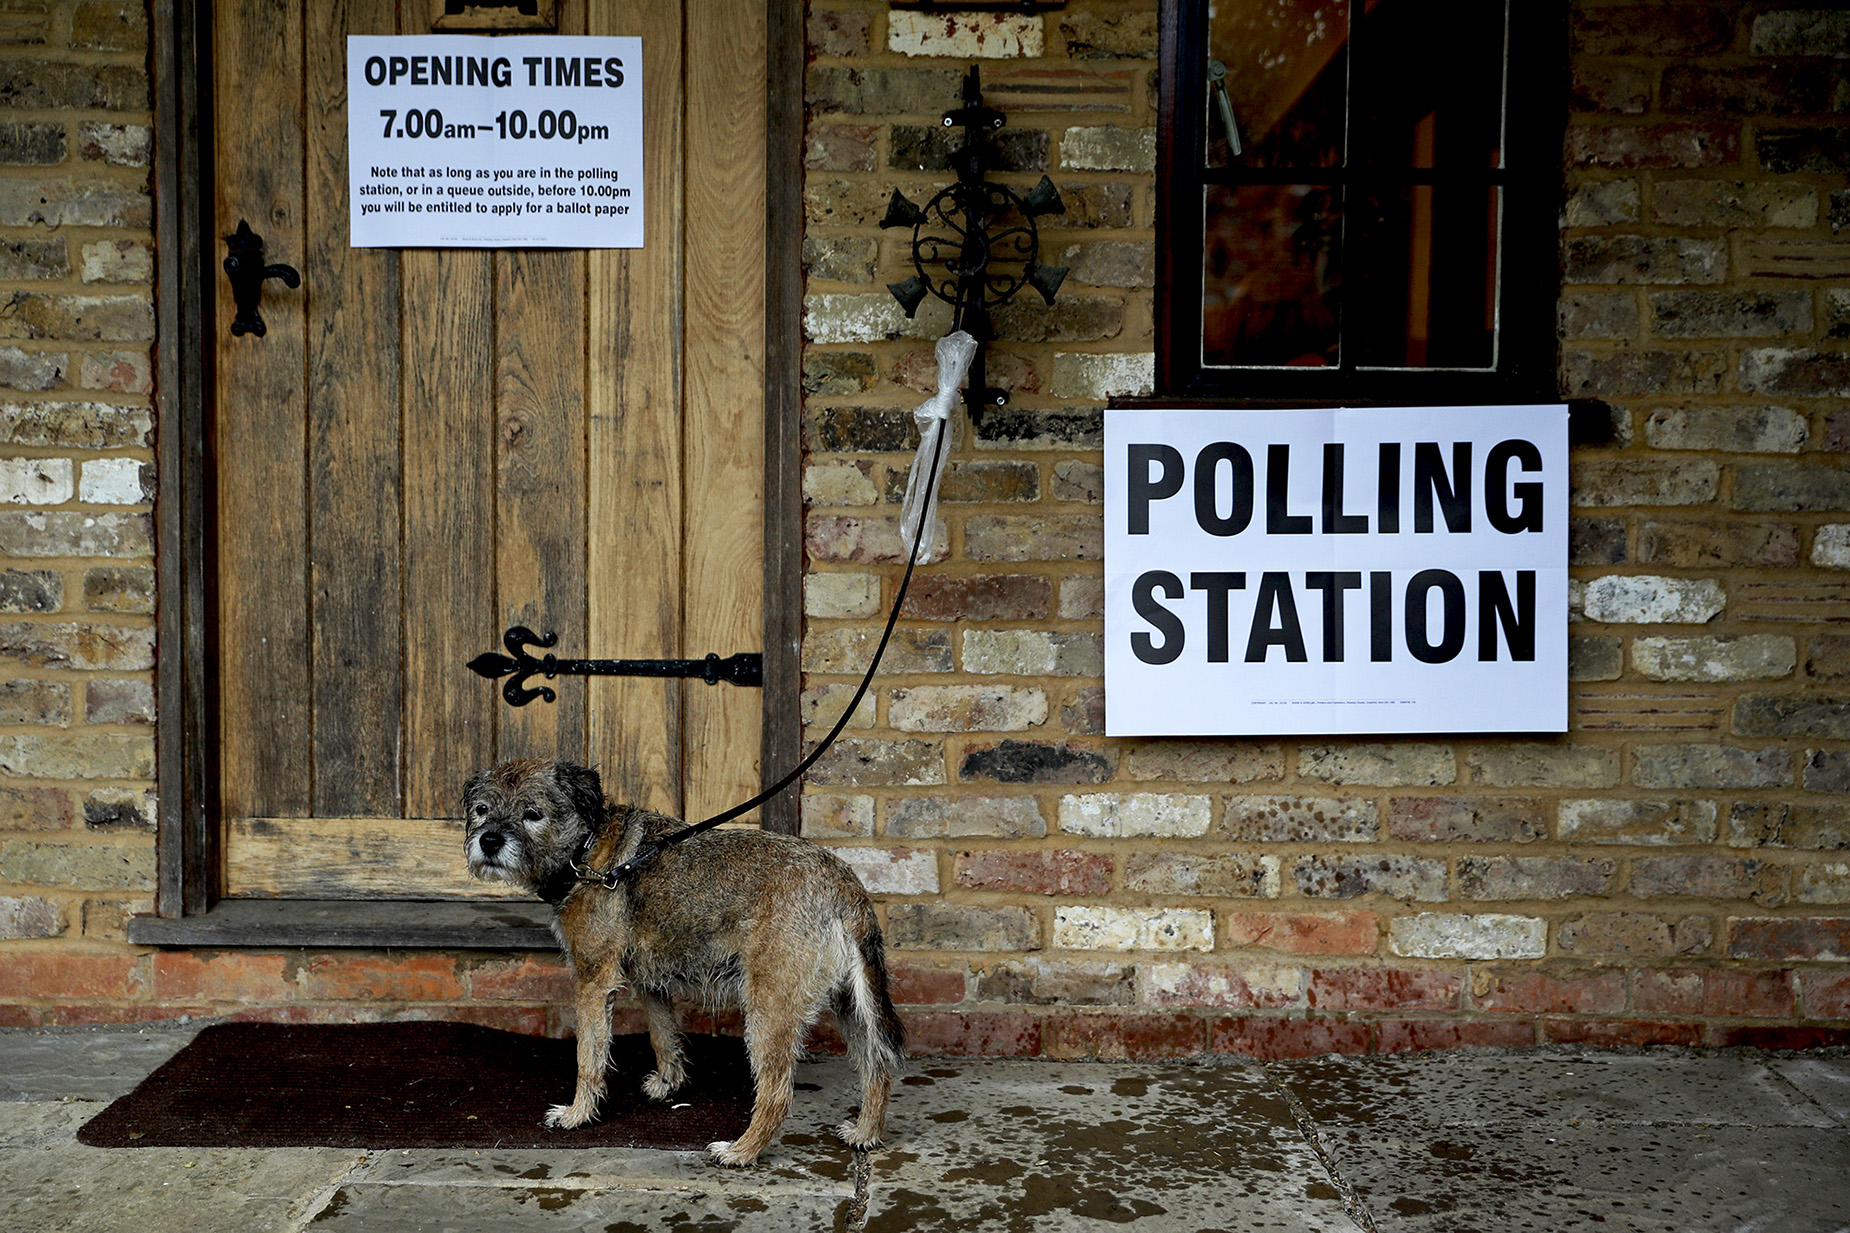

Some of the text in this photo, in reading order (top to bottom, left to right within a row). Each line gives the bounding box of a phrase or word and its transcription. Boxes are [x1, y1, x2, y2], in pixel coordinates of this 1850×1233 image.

[364, 55, 625, 89] OPENING TIMES
[370, 165, 619, 183] Note that as long as you are in the polling
[359, 183, 631, 200] station, or in a queue outside, before 10.00pm
[360, 200, 630, 218] you will be entitled to apply for a ballot paper
[1127, 438, 1544, 538] POLLING
[1130, 568, 1537, 666] STATION
